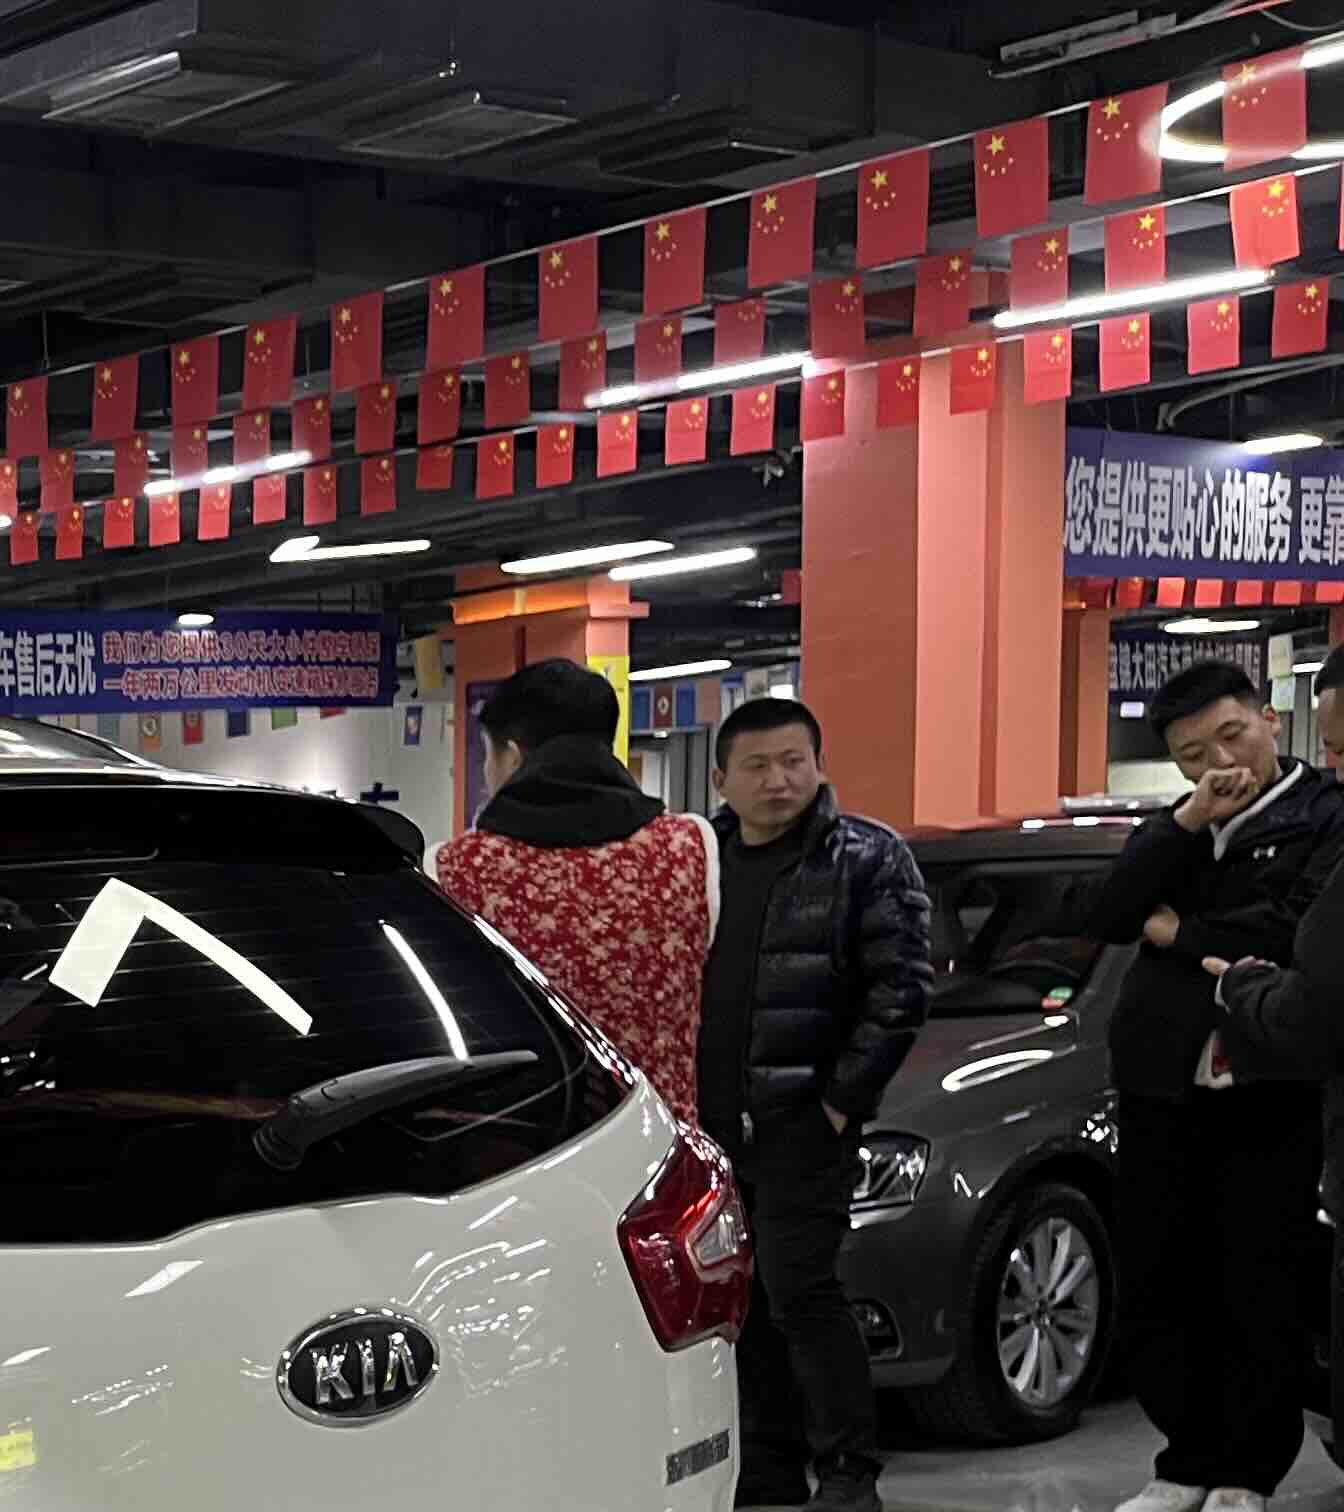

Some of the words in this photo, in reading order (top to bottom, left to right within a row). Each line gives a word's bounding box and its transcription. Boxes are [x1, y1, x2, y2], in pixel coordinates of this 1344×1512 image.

[1065, 456, 1292, 564] 您提供更贴心的服务
[312, 1330, 419, 1404] KIA
